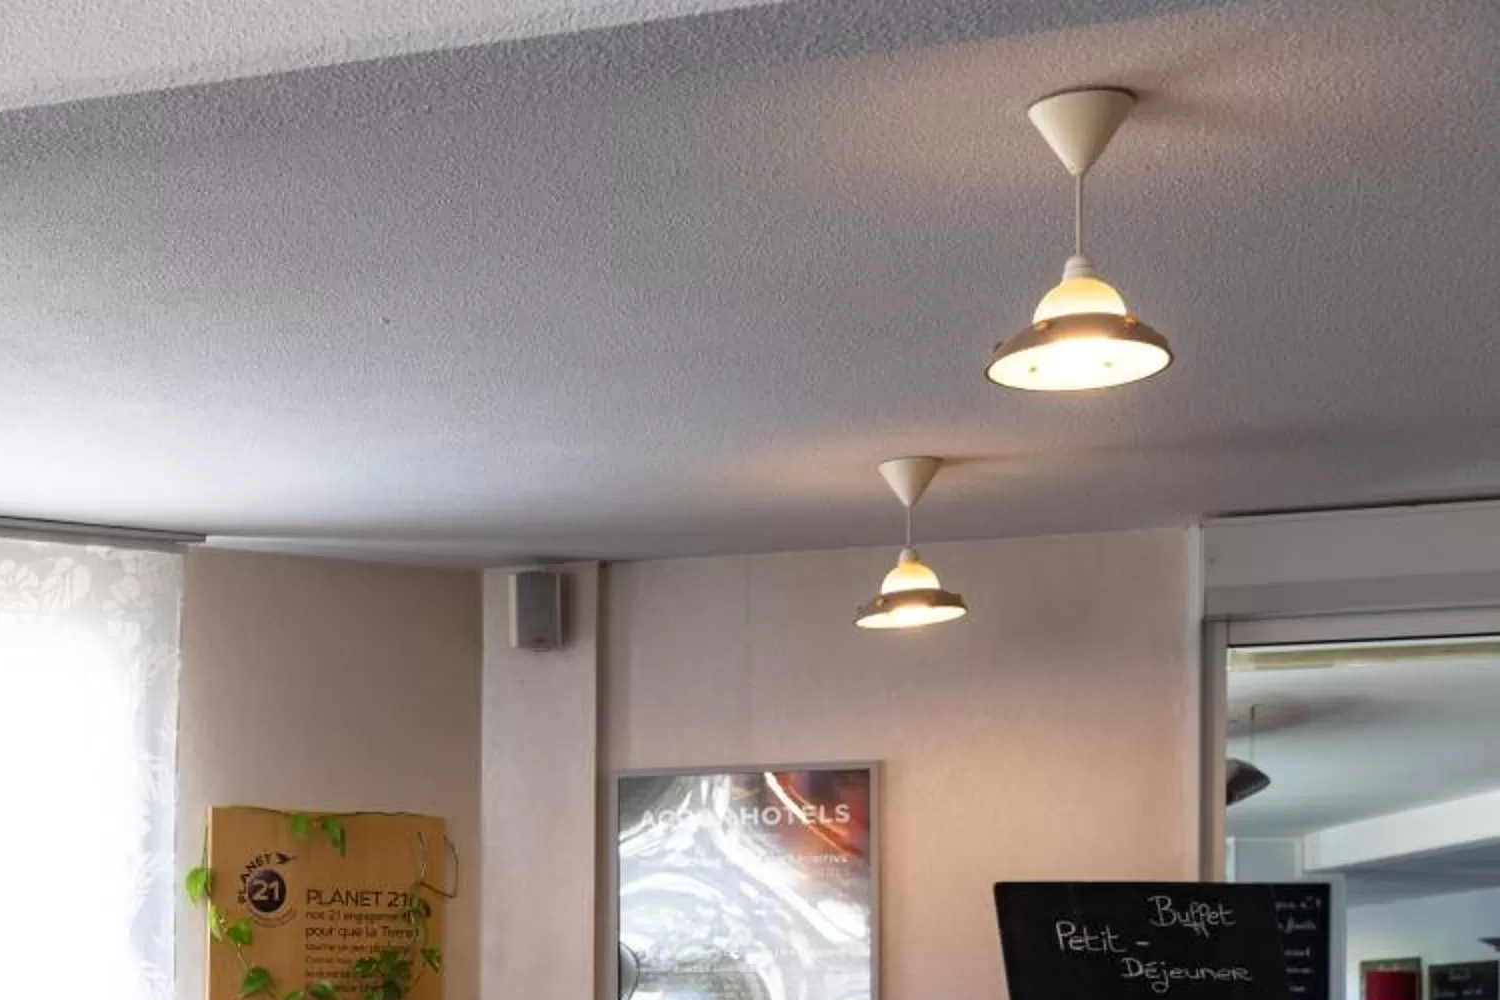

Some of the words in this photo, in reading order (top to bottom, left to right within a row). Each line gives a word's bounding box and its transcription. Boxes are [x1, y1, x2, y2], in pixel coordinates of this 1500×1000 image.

[252, 880, 279, 900] 21
[306, 887, 382, 907] PLANET
[1147, 895, 1236, 939] Buffet
[1055, 920, 1126, 952] Petit
